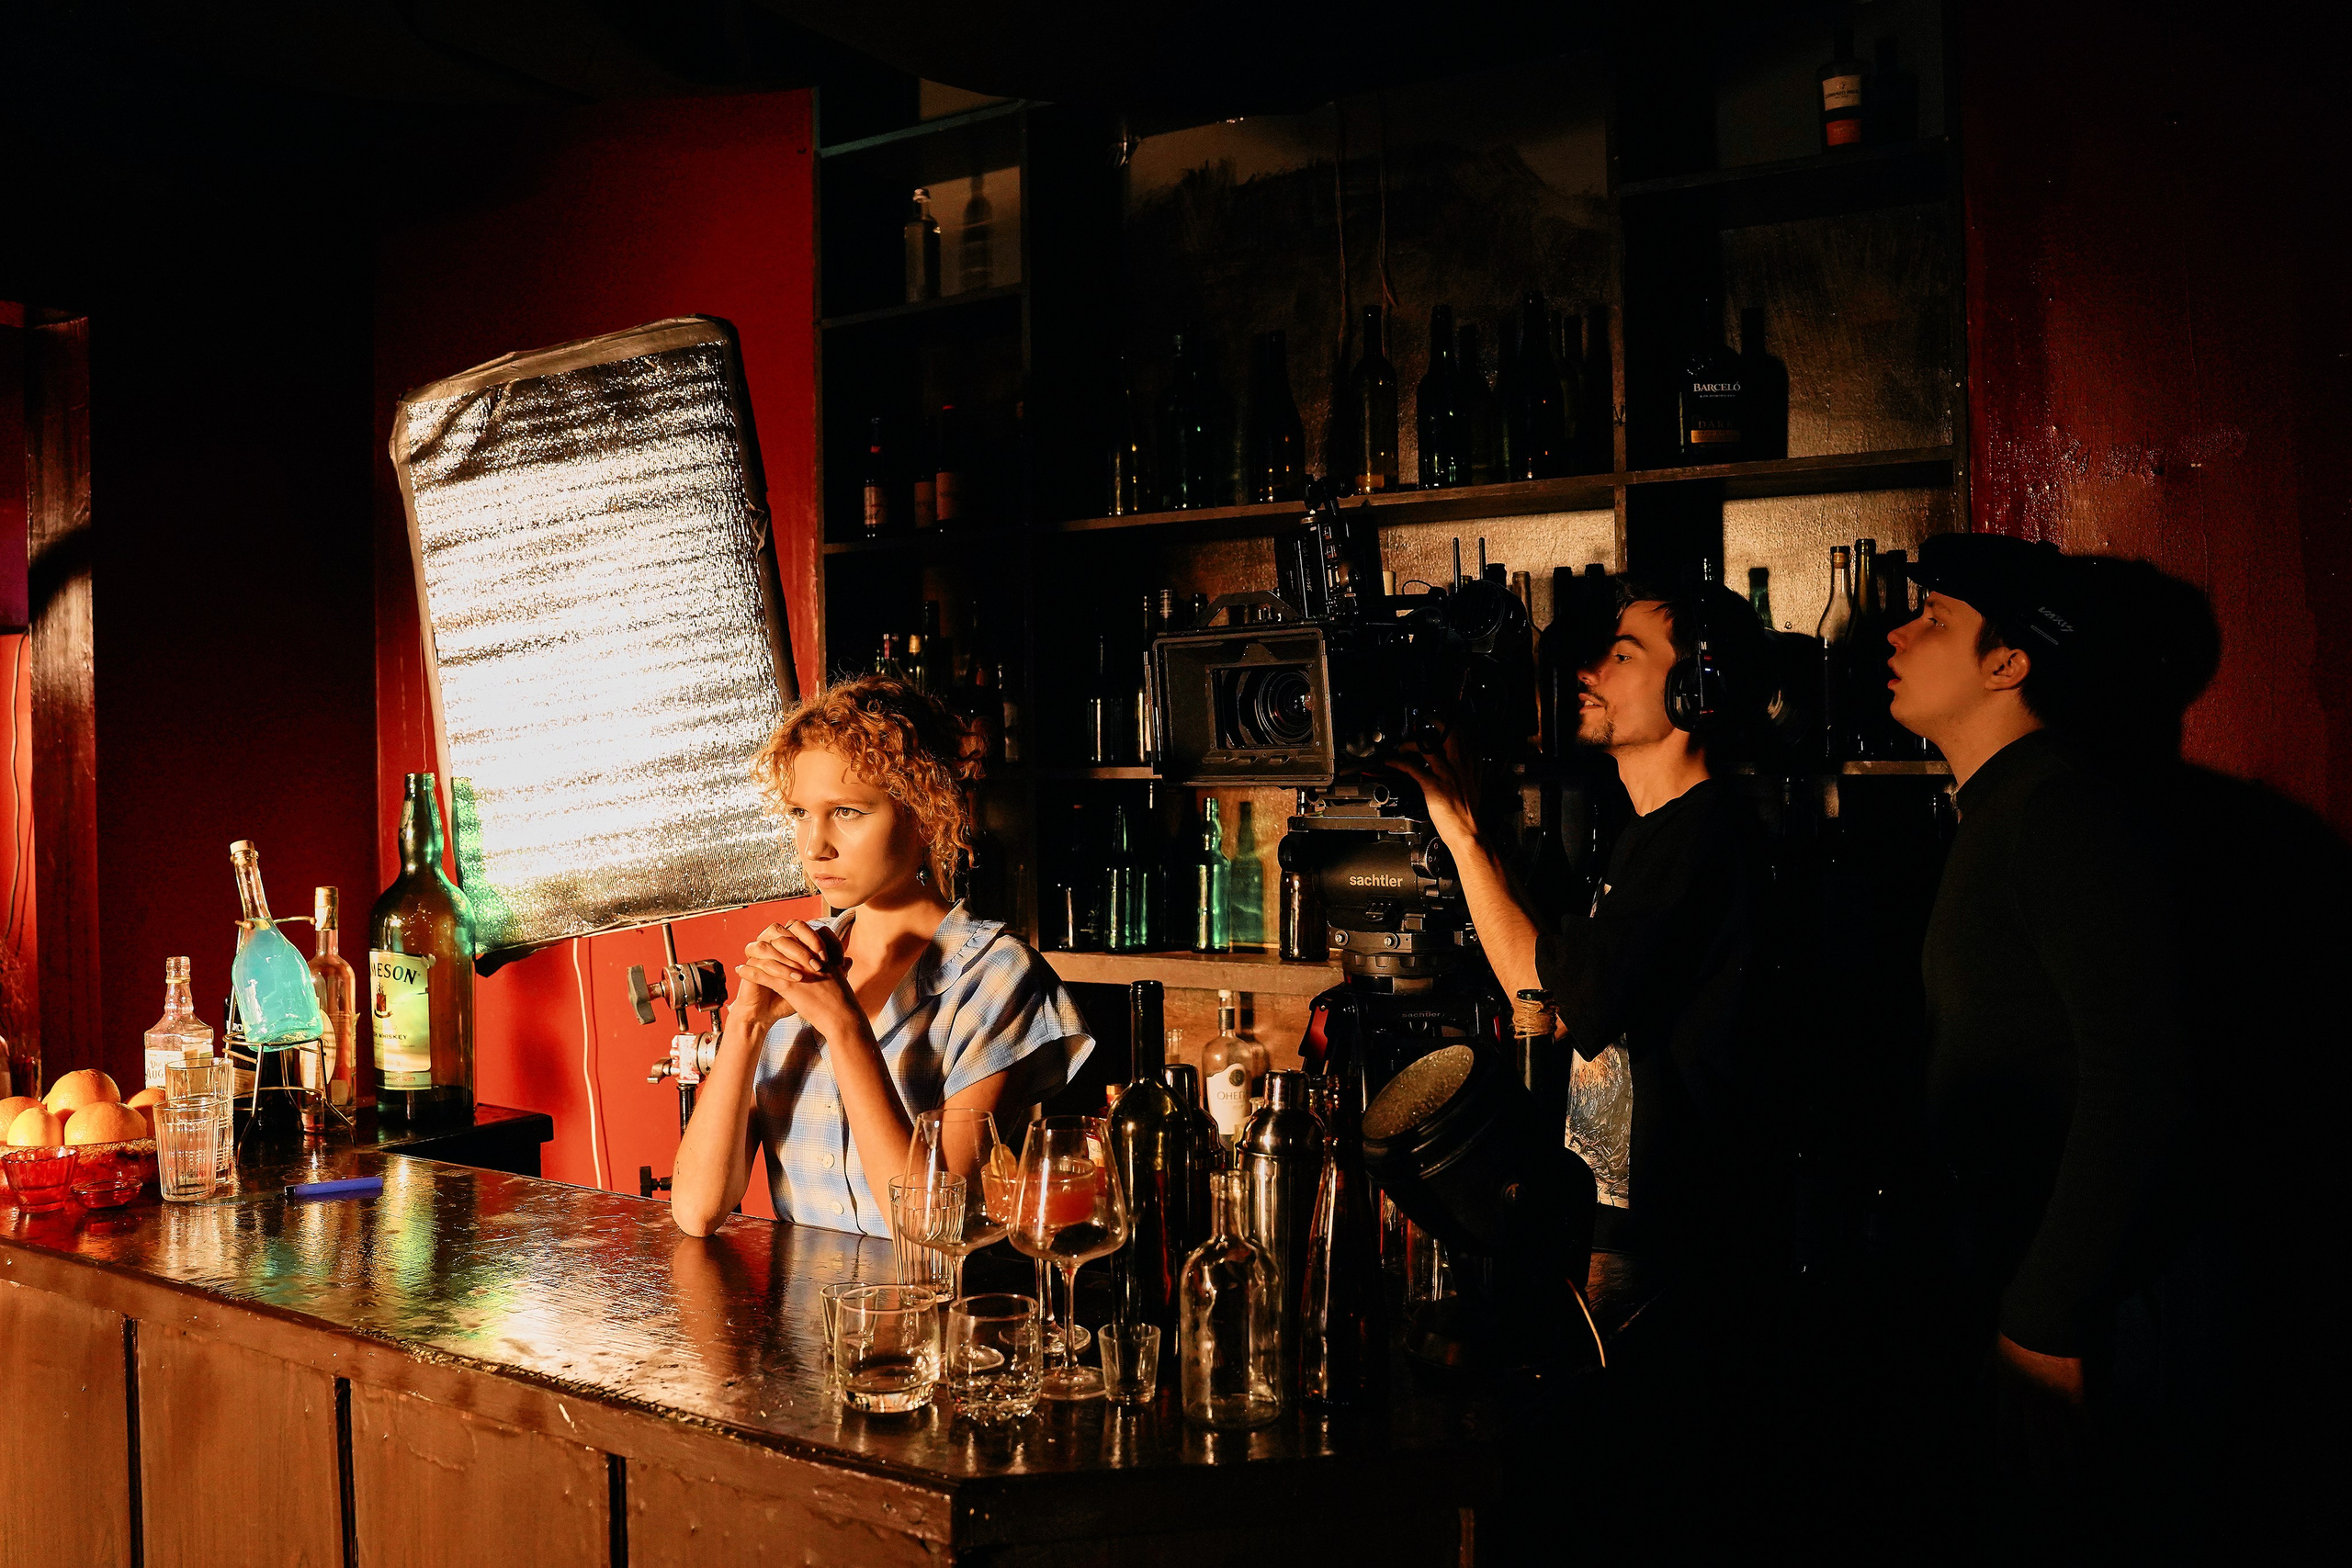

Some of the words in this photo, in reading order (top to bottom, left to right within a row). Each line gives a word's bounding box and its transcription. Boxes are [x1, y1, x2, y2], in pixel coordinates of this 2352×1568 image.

[1693, 380, 1741, 392] BARCELÓ
[1698, 420, 1734, 429] DARK
[1349, 874, 1403, 887] sachtler
[371, 963, 417, 985] MESON
[146, 1067, 164, 1079] AUG
